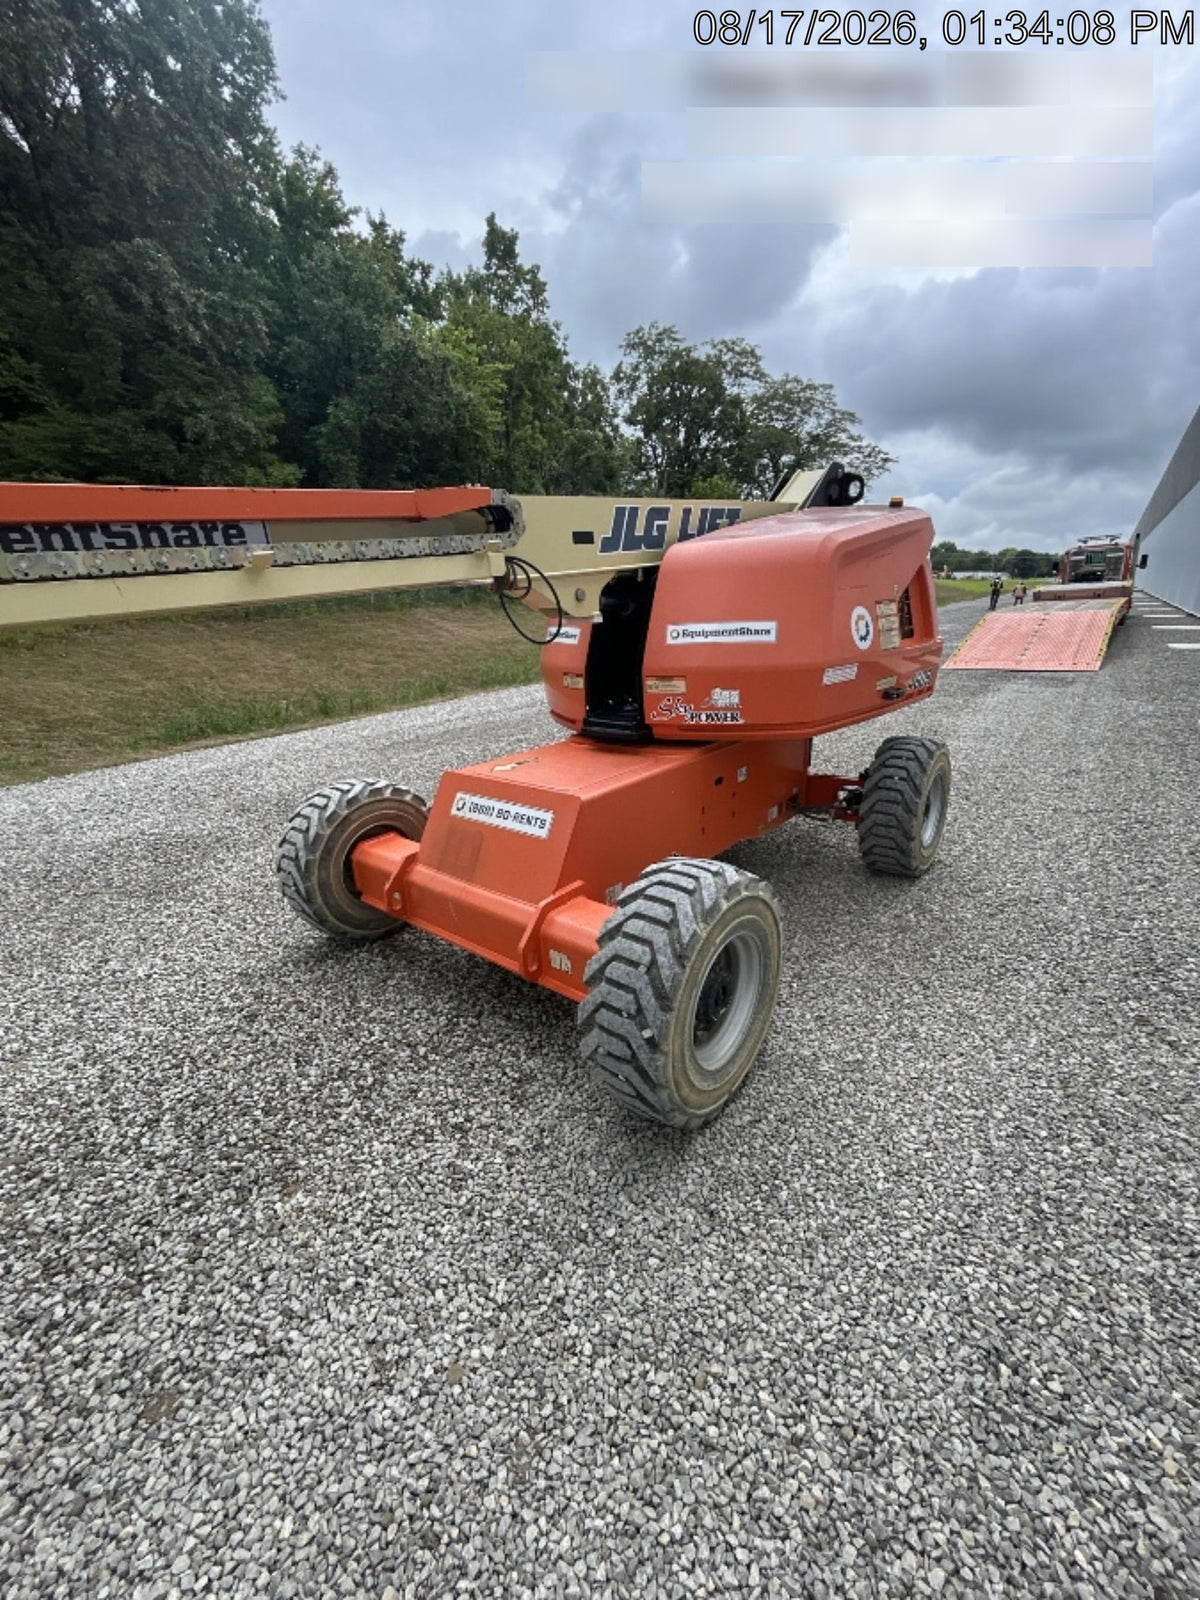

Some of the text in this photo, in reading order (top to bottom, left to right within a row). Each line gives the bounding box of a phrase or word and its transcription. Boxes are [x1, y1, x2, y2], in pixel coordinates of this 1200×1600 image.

[599, 505, 671, 555] JLG
[681, 626, 773, 639] EquipmentShare
[688, 710, 741, 724] POWER
